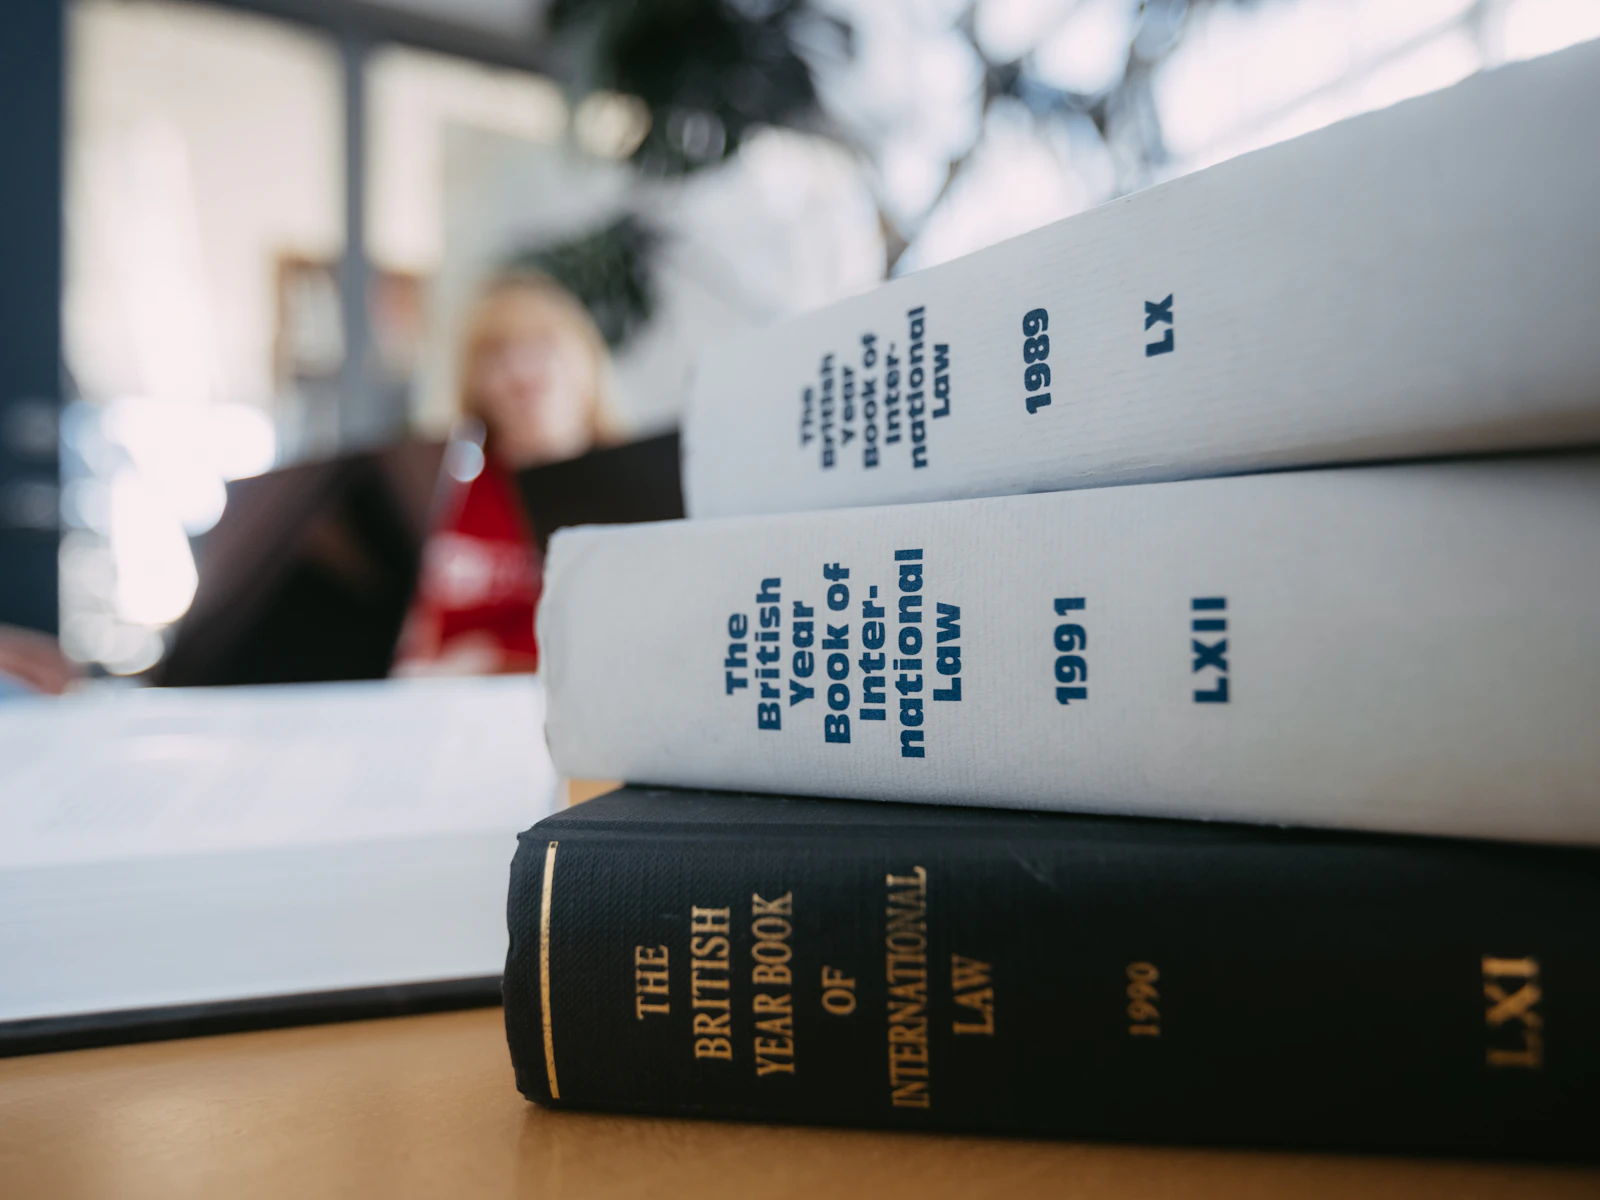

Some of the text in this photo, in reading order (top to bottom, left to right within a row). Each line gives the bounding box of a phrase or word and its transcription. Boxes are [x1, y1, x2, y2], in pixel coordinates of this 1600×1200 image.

[1022, 308, 1052, 415] 1989
[1144, 293, 1175, 358] LX
[801, 385, 814, 447] The
[819, 353, 836, 470] British
[841, 366, 856, 446] Year
[861, 334, 879, 469] Book of
[884, 342, 901, 445] Inter-
[906, 306, 928, 469] national
[932, 343, 950, 419] Law
[724, 613, 749, 696] The
[754, 577, 782, 731] British
[789, 600, 815, 707] Year
[821, 562, 851, 744] Book of
[858, 585, 887, 721] Inter-
[892, 548, 926, 759] national
[932, 602, 962, 702] Law
[1053, 597, 1088, 705] 1991
[1191, 597, 1229, 704] LXII
[634, 945, 671, 1020] THE
[689, 905, 733, 1061] BRITISH
[751, 892, 795, 1076] YEAR BOOK
[821, 965, 857, 1015] OF
[885, 865, 931, 1109] INTERNATIONAL
[951, 954, 995, 1035] LAW
[1126, 961, 1160, 1037] 1990
[1481, 955, 1542, 1067] LXI
